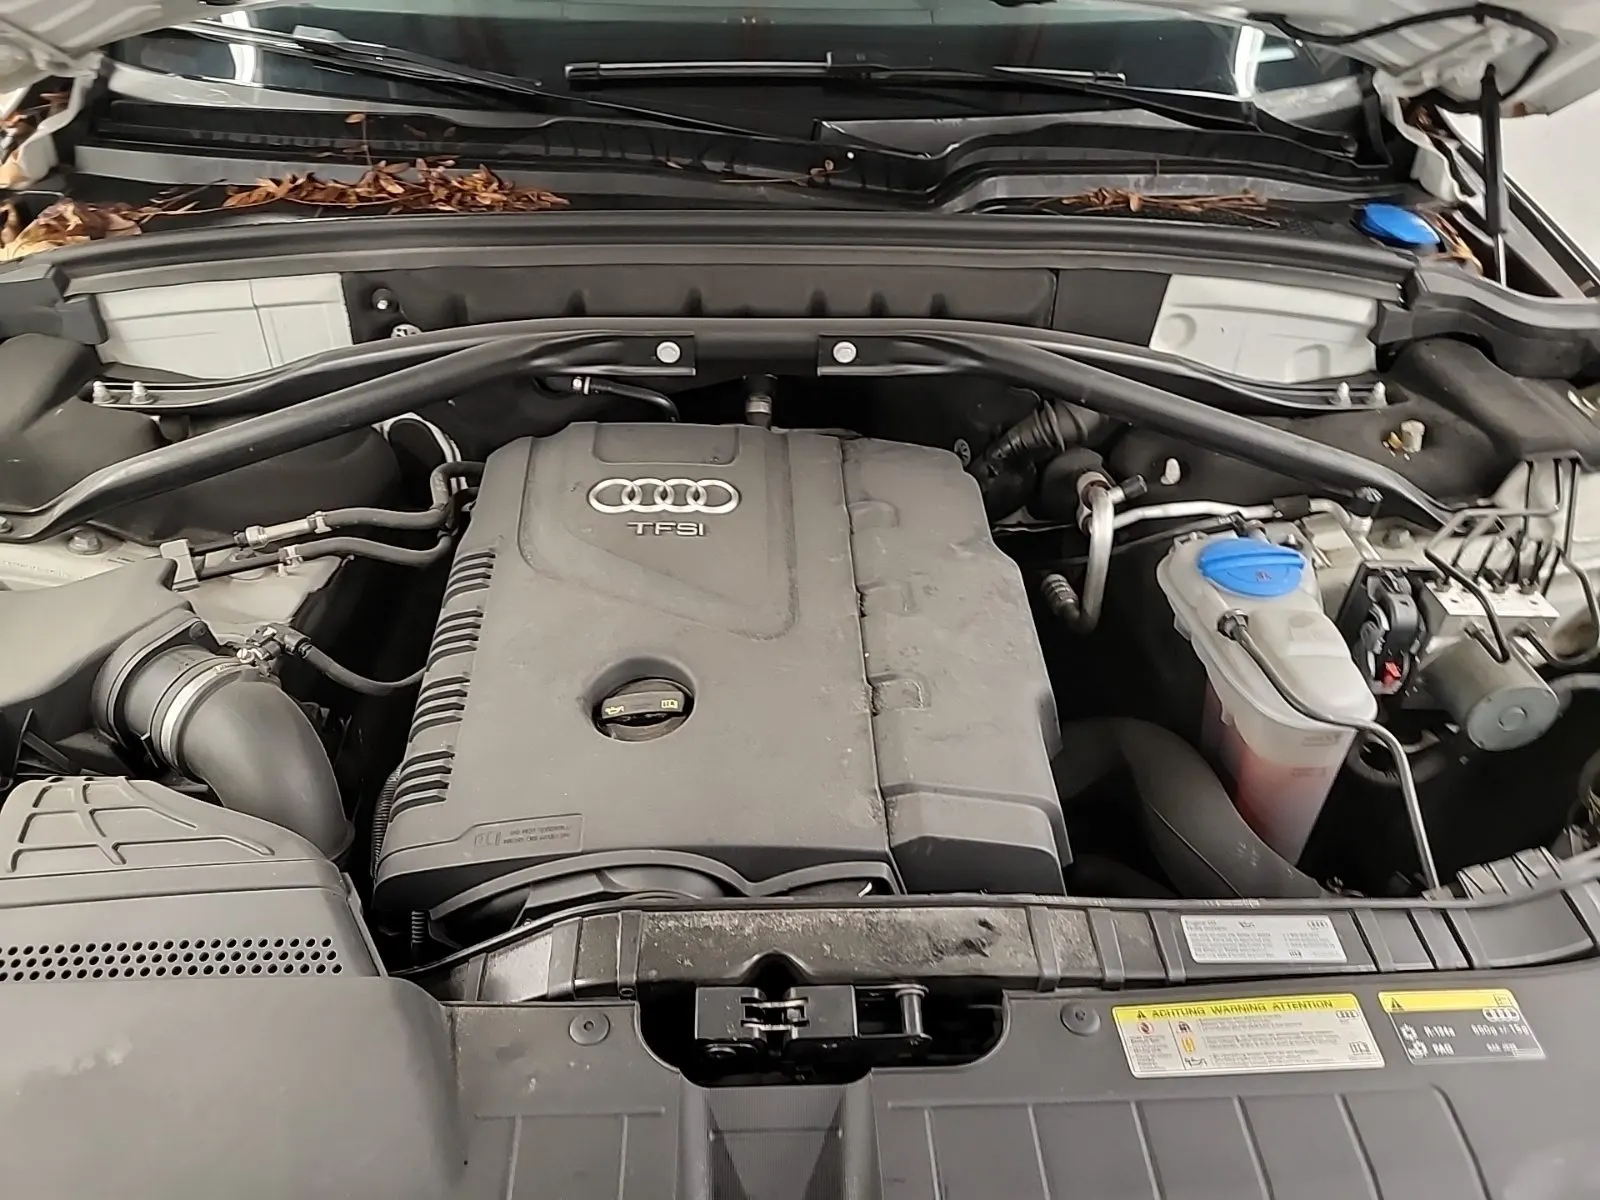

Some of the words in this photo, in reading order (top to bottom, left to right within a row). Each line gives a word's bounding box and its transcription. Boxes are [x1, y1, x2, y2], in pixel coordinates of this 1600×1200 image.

[627, 521, 704, 536] TFSI
[1152, 1007, 1205, 1019] ACHTUNG
[1211, 1002, 1267, 1015] WARNING
[1273, 999, 1334, 1011] ATTENTION
